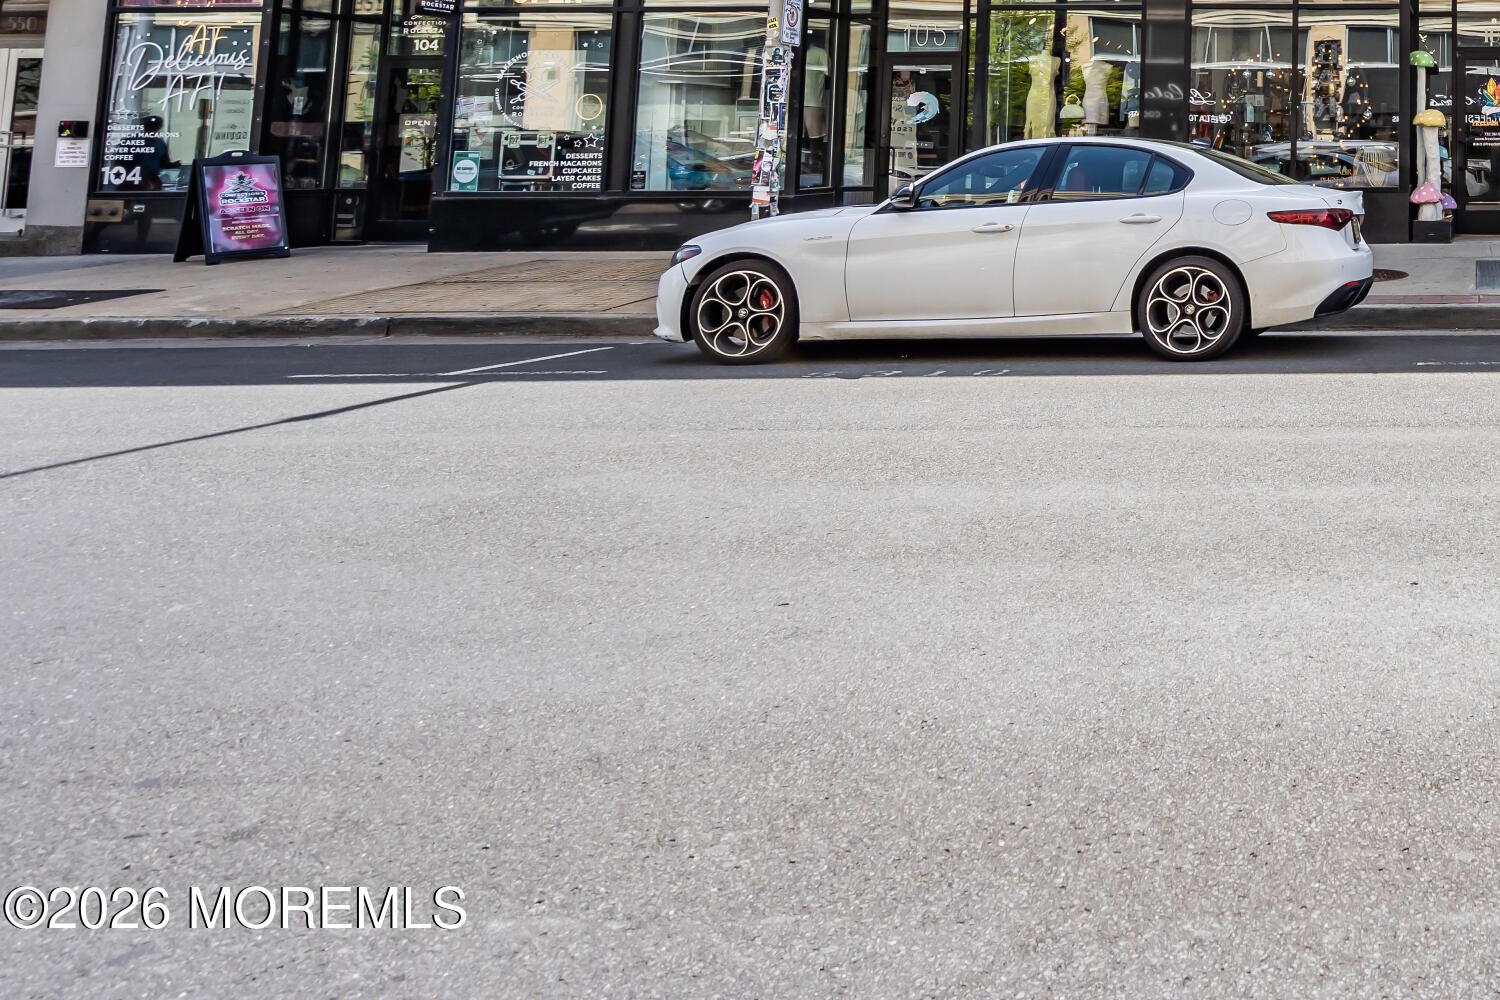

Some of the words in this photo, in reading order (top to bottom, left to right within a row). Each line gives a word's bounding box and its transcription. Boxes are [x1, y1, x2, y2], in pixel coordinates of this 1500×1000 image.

[421, 1, 455, 10] ROCKSTAR
[413, 39, 439, 51] 104
[903, 24, 947, 48] 105
[126, 34, 249, 91] Delicious
